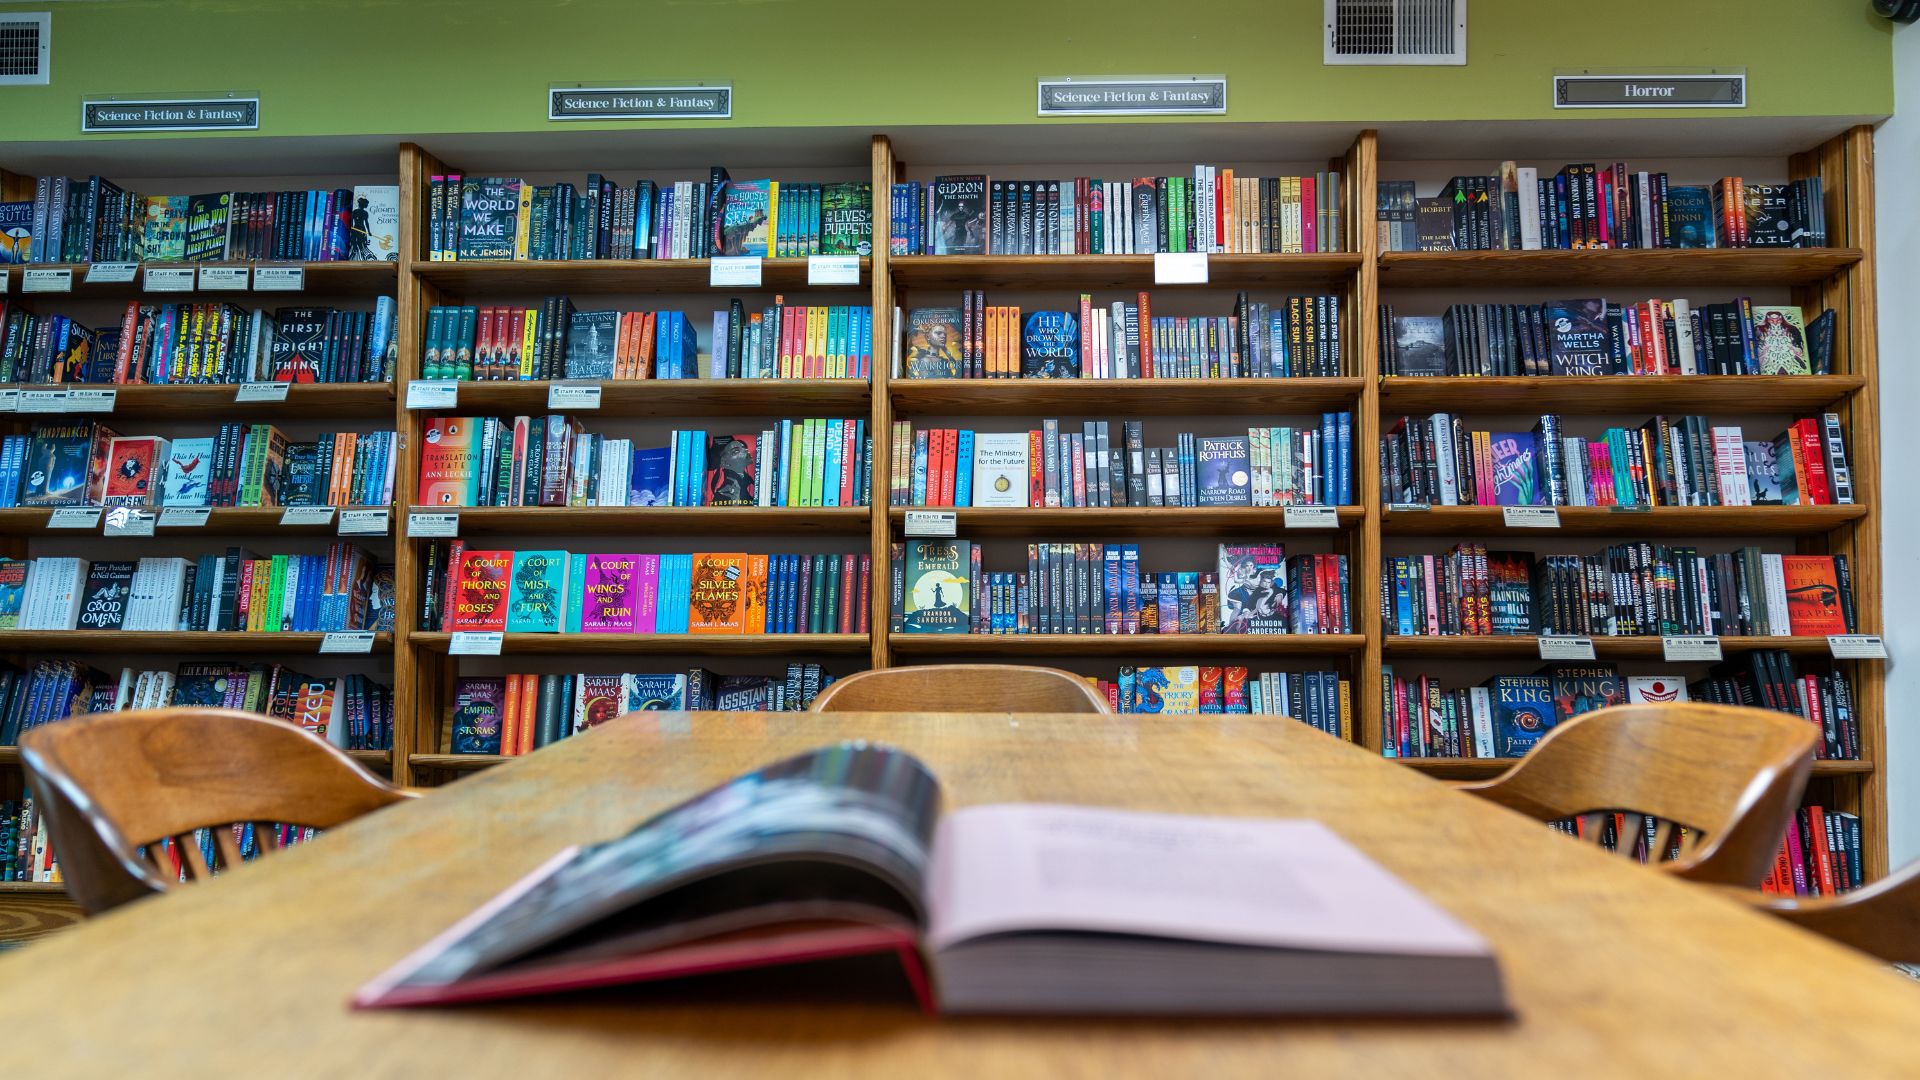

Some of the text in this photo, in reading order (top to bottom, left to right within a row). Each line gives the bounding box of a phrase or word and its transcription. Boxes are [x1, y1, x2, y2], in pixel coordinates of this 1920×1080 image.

[1625, 85, 1675, 97] Horror
[1055, 91, 1211, 103] Science Fiction & Fantasy
[565, 97, 716, 109] Science Fiction & Fantasy
[98, 109, 243, 122] Science Fiction & Fantasy
[485, 187, 504, 196] THE
[739, 191, 763, 201] HOUSE
[369, 205, 396, 214] Gloom
[466, 200, 515, 211] WORLD
[727, 201, 768, 211] CERULEAN
[189, 207, 229, 231] LONG WAY
[473, 213, 491, 222] WE
[725, 213, 749, 225] SEA
[834, 210, 866, 222] LIVES
[1036, 202, 1045, 232] NONA
[464, 224, 504, 235] MAKE
[824, 223, 872, 235] PUPPETS
[187, 237, 225, 255] ANGRY PLANET
[479, 248, 511, 256] JEMISIN
[1039, 316, 1060, 327] HE
[1126, 307, 1139, 345] BLUEBIRD
[1291, 298, 1300, 344] BLACK SUN
[283, 324, 322, 333] FIRST
[1026, 334, 1072, 342] DROWNED
[274, 342, 323, 352] BRIGHT
[1026, 347, 1073, 357] WORLD
[132, 343, 140, 363] COOK
[1556, 353, 1609, 365] WITCH
[275, 361, 319, 370] THING
[1566, 366, 1602, 376] KING
[1204, 441, 1244, 450] PATRICK
[994, 450, 1023, 459] Ministry
[1200, 451, 1246, 462] ROTHFUSS
[426, 470, 440, 478] ANN
[104, 495, 146, 507] AXIOM'S END
[917, 544, 959, 560] TRESS
[475, 560, 509, 568] COURT
[527, 559, 560, 567] COURT
[590, 561, 635, 570] A COURT
[696, 559, 742, 567] A COURT
[918, 562, 959, 570] EMERALD
[1787, 562, 1825, 571] DON'T
[462, 581, 507, 590] THORNS
[524, 580, 551, 589] MIST
[699, 581, 736, 589] SILVER
[1792, 578, 1824, 586] FEAR
[587, 584, 624, 594] WINGS
[695, 592, 738, 600] FLAMES
[1491, 591, 1530, 601] HAUNTING
[87, 600, 121, 611] GOOD
[458, 604, 494, 613] ROSES
[520, 603, 549, 613] FURY
[603, 607, 631, 616] RUIN
[1557, 668, 1613, 679] STEPHEN
[639, 681, 666, 689] SARAH
[1500, 679, 1549, 687] STEPHEN
[588, 688, 616, 697] MAAS
[642, 688, 668, 698] MAAS
[1558, 681, 1615, 697] KING
[1164, 691, 1193, 699] PRIORY
[1501, 689, 1550, 703] KING
[464, 707, 495, 715] EMPIRE
[460, 726, 496, 735] STORMS
[1507, 737, 1534, 751] FAIRY
